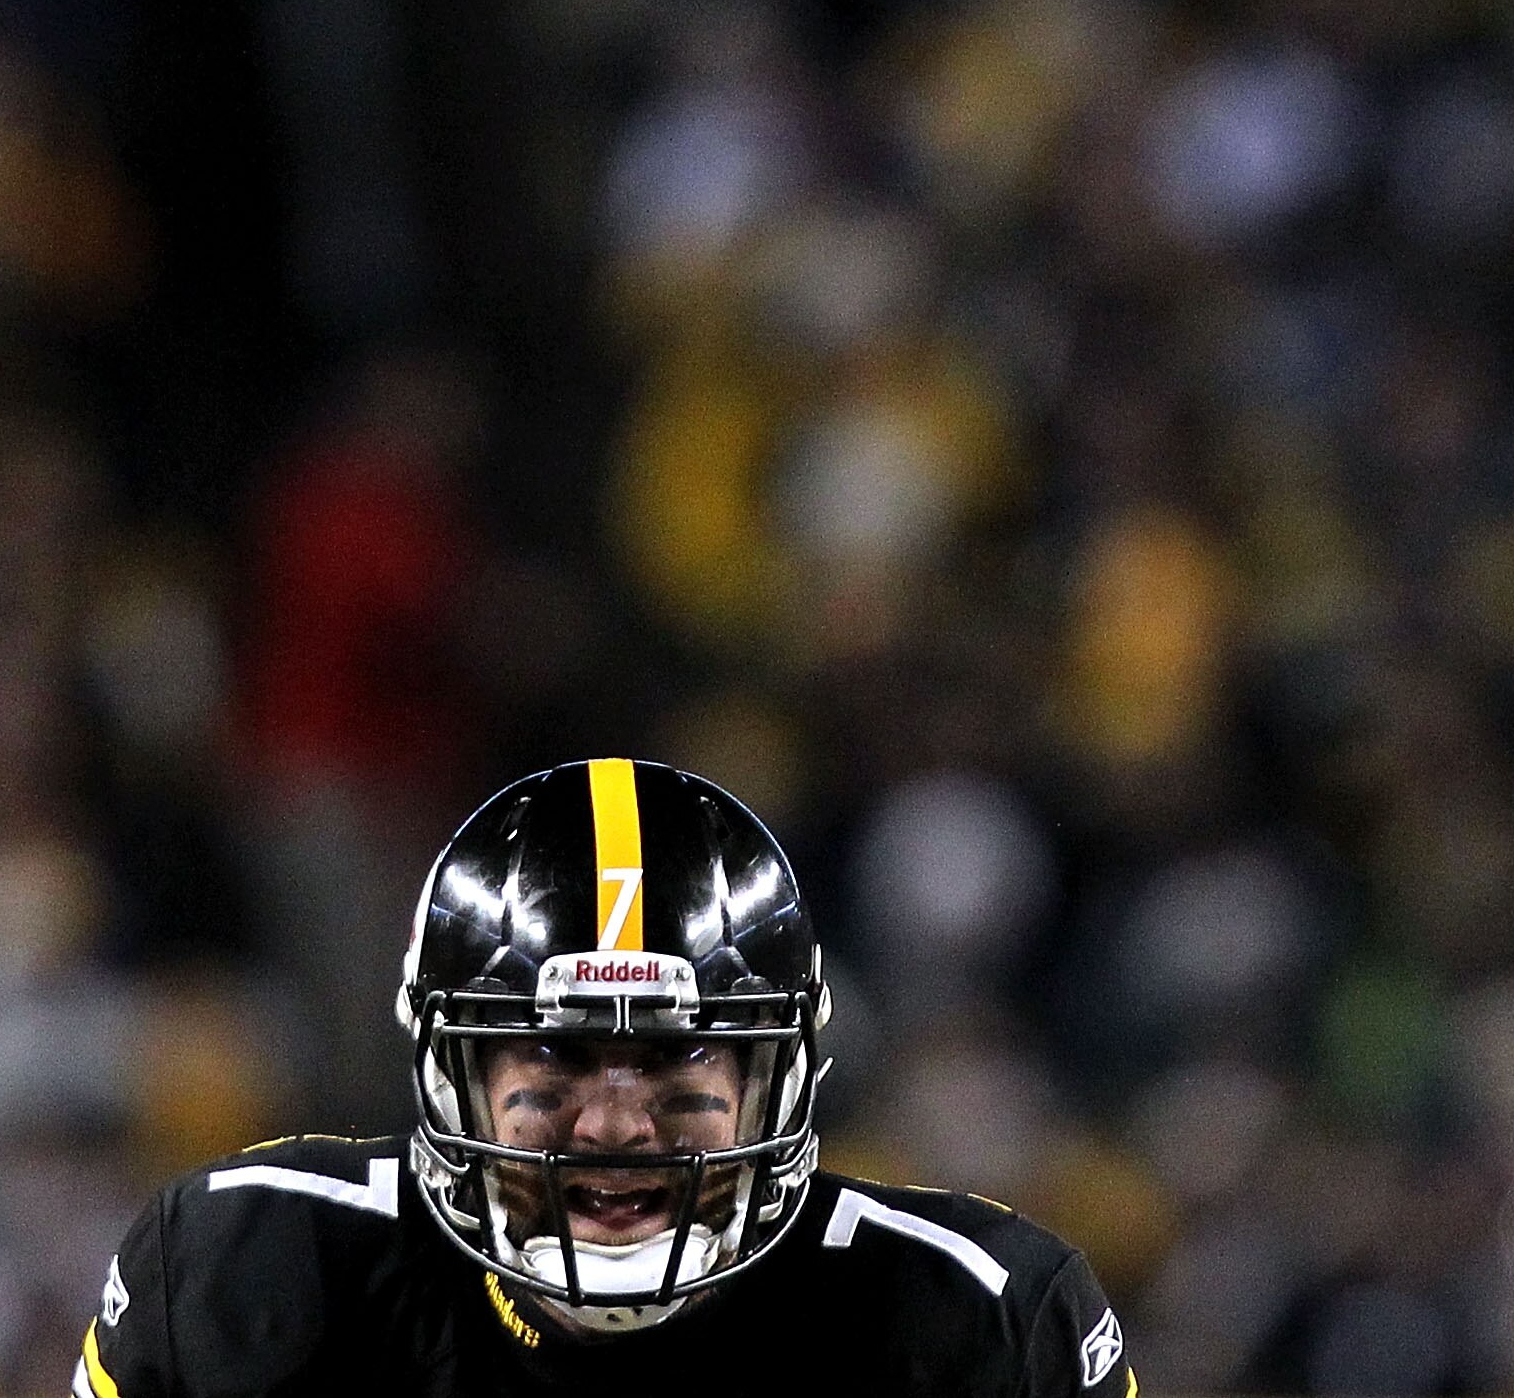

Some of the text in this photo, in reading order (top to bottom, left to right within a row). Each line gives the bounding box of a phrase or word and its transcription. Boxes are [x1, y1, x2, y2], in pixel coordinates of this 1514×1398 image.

[597, 868, 644, 951] 7
[576, 960, 660, 982] Riddell
[208, 1157, 399, 1219] 7
[821, 1187, 1010, 1297] 7
